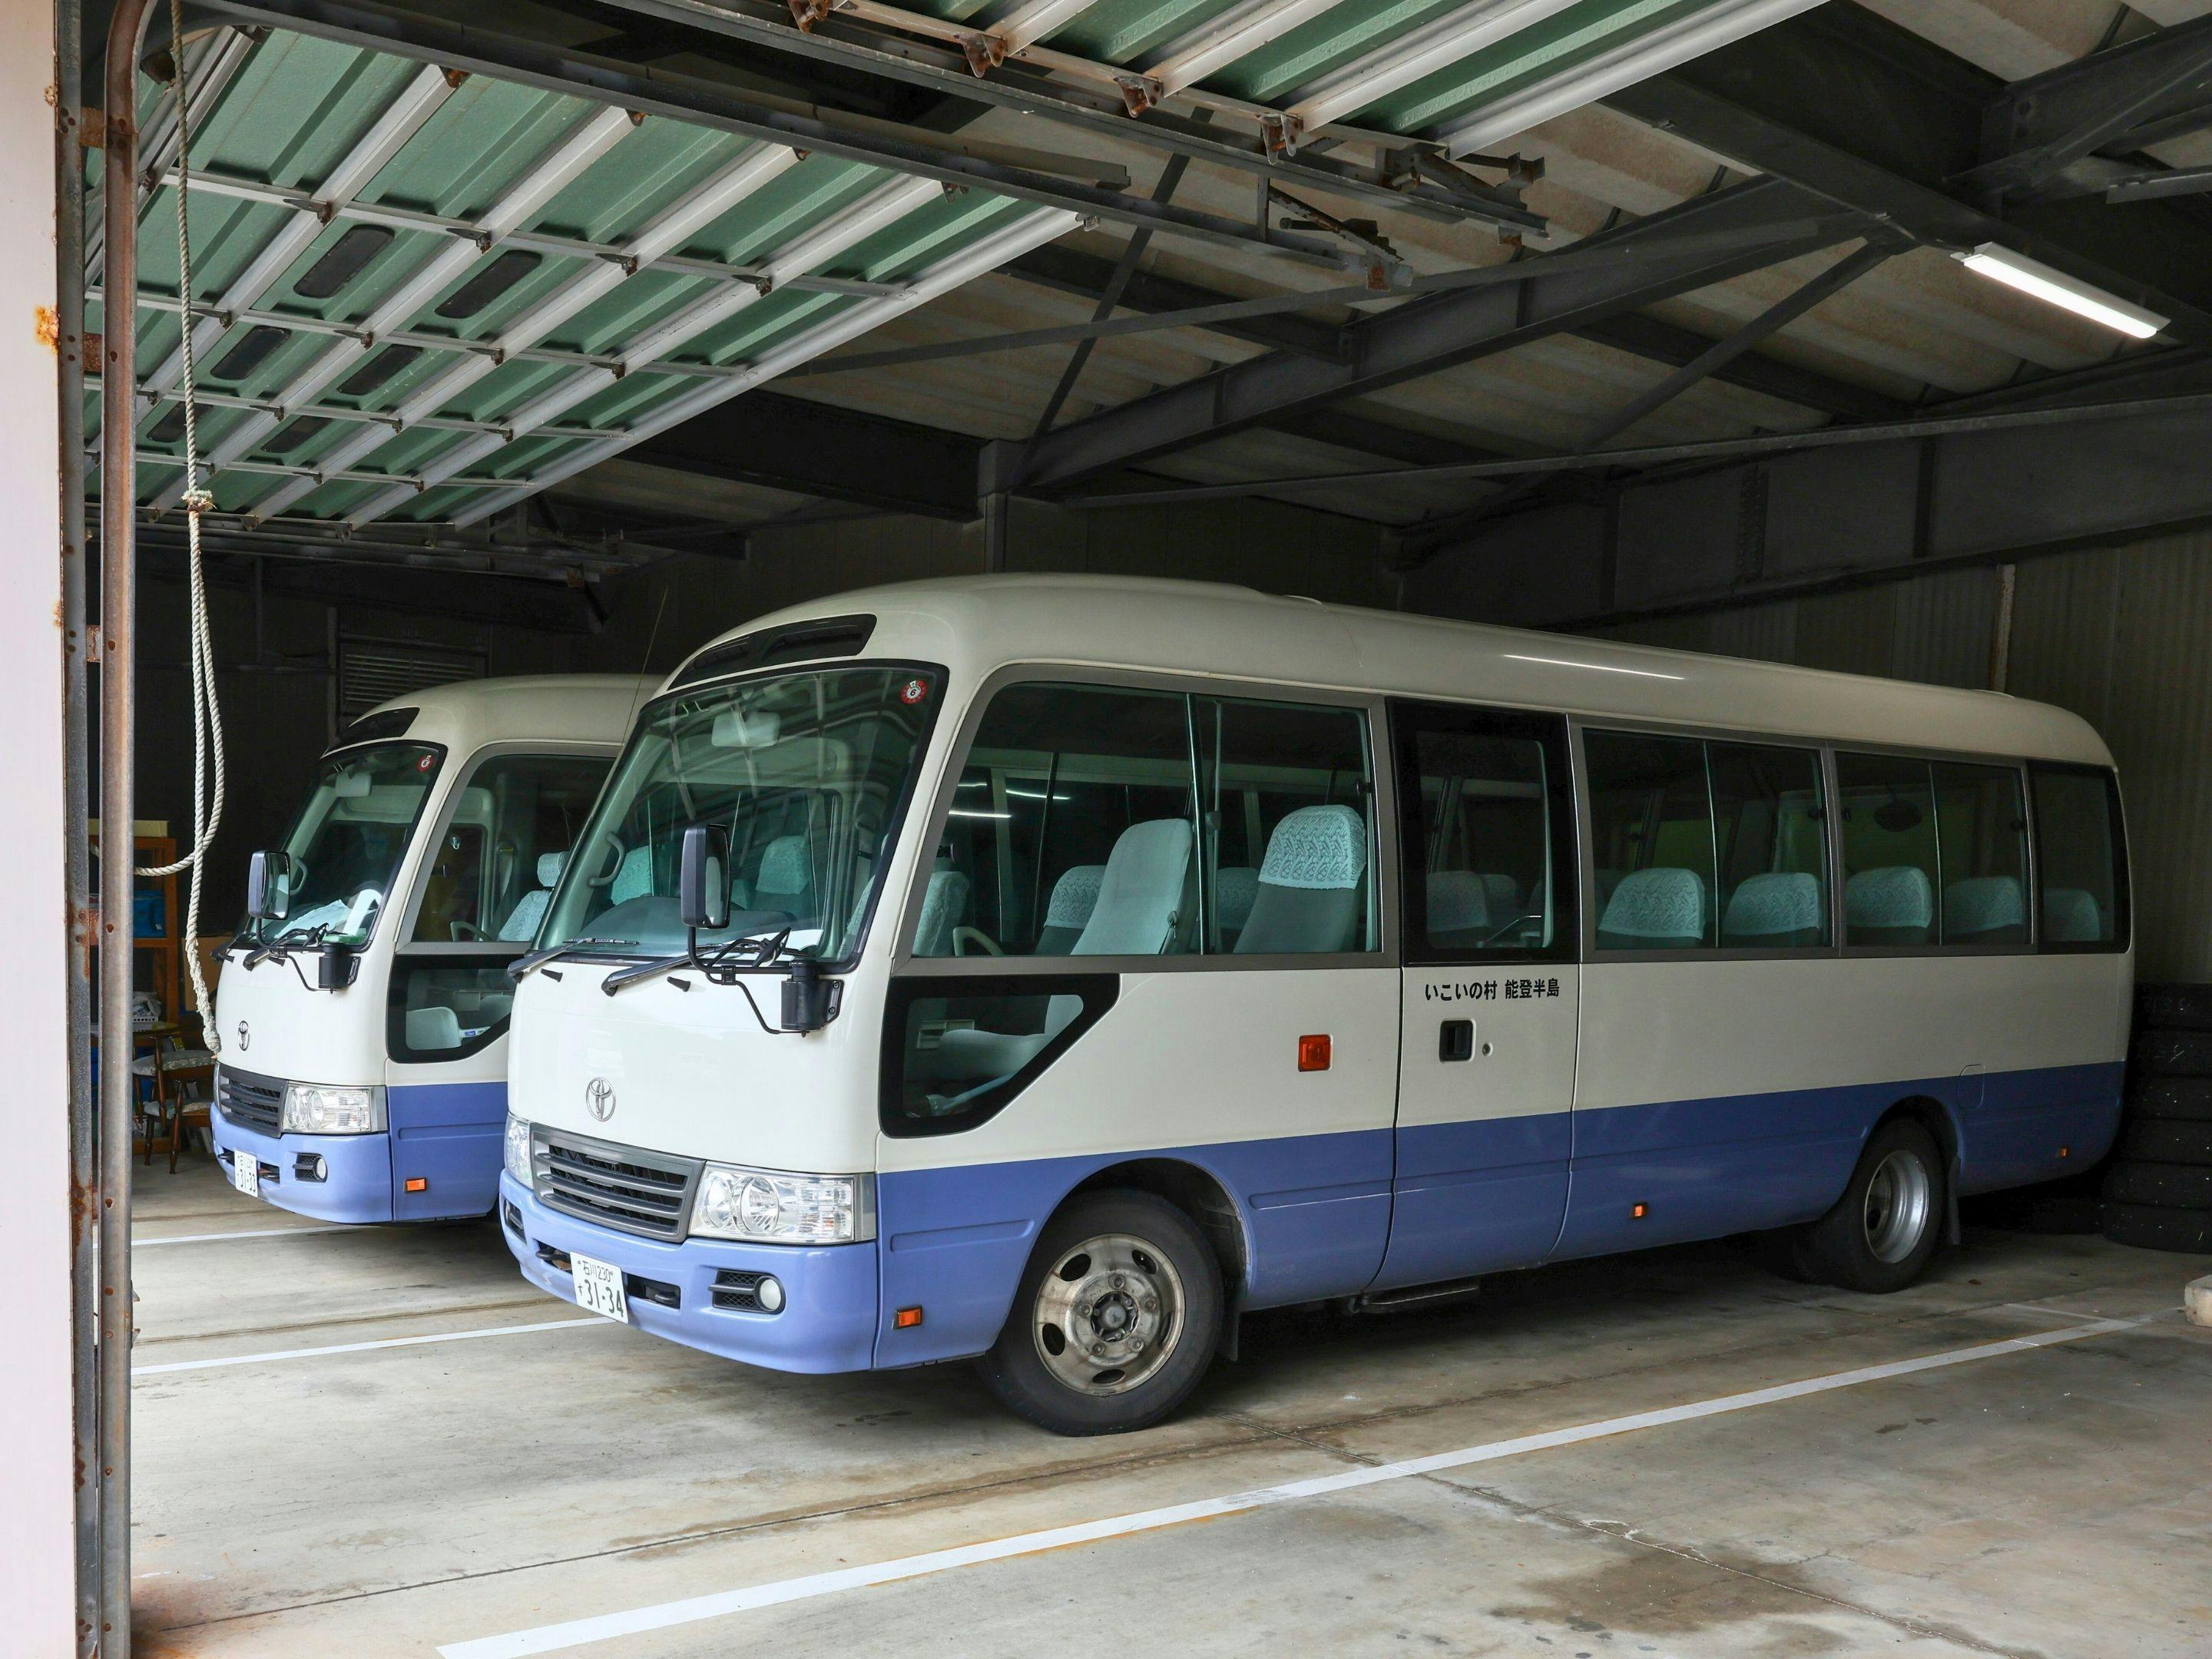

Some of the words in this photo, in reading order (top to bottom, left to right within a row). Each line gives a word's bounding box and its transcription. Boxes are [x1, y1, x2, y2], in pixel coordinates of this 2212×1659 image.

[1425, 980, 1498, 1002] いこいの村
[1505, 978, 1560, 999] 能登半島
[584, 1279, 624, 1317] 31-34
